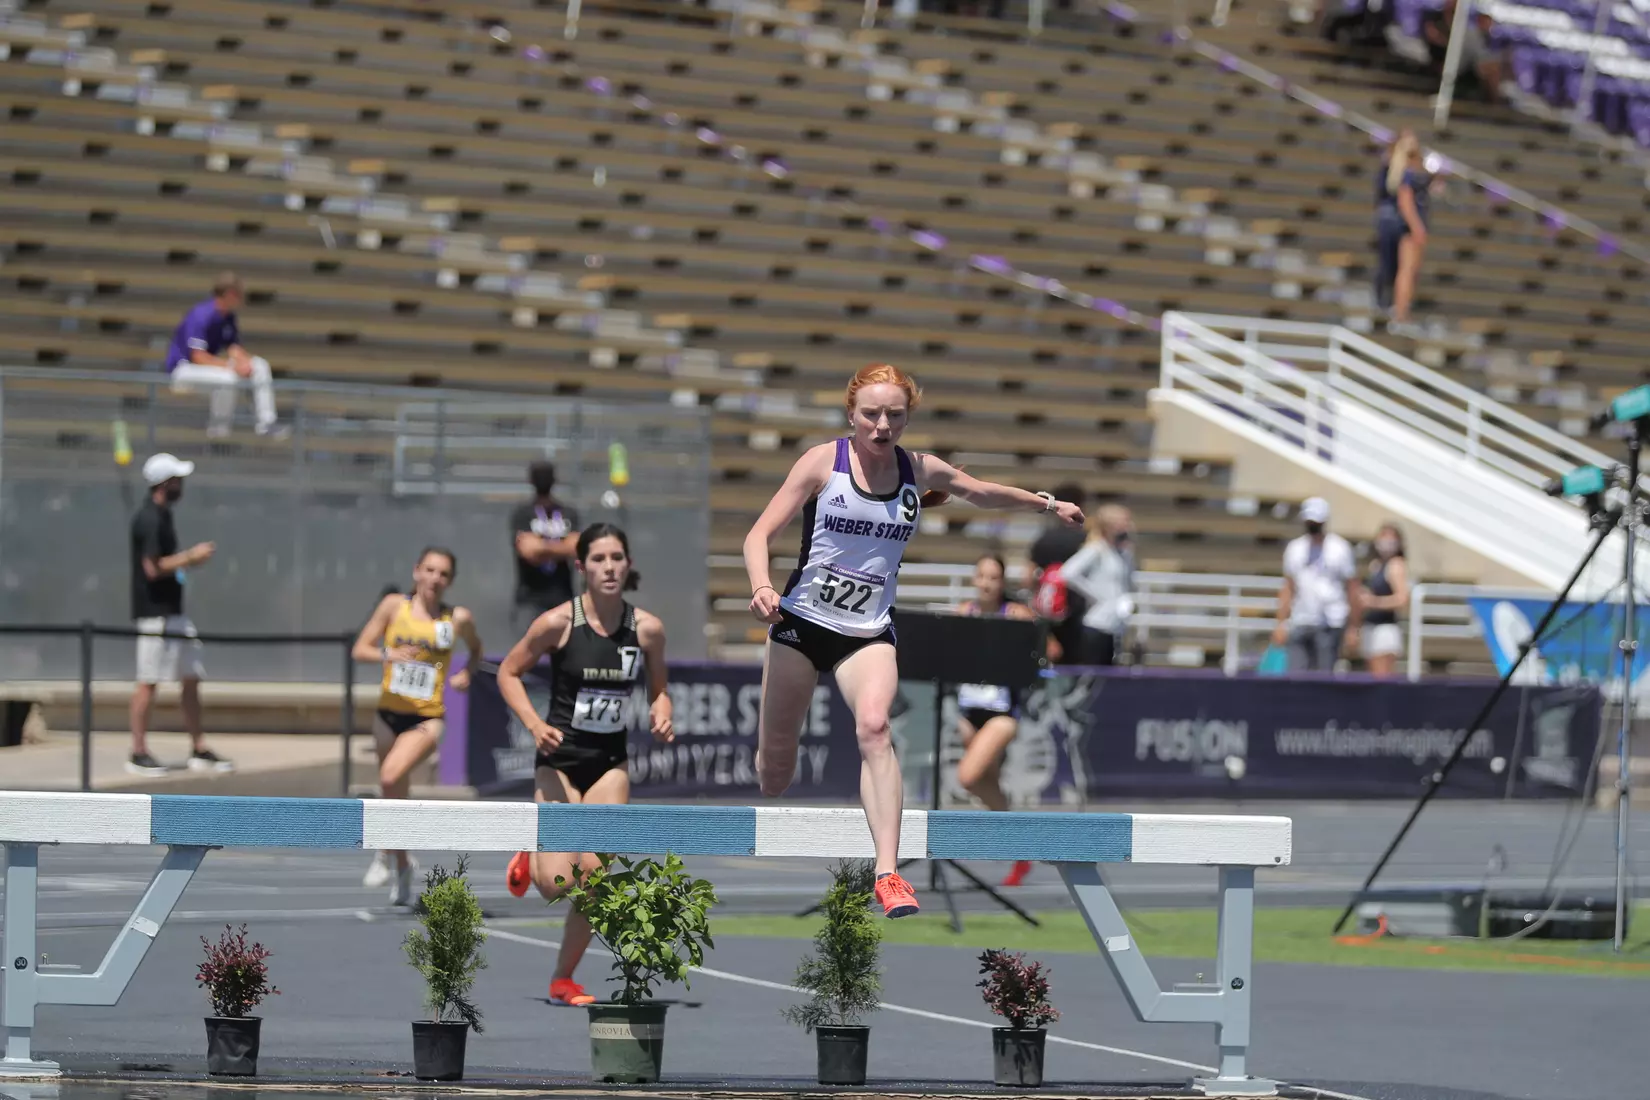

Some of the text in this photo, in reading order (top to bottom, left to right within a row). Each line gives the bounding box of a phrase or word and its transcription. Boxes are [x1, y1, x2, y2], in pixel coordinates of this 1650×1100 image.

[827, 500, 848, 510] adidas
[902, 488, 918, 522] 9
[824, 513, 914, 542] WEBER STATE
[819, 573, 873, 615] 522
[626, 650, 637, 677] 7
[583, 697, 622, 723] 173
[1135, 718, 1249, 763] FUSION
